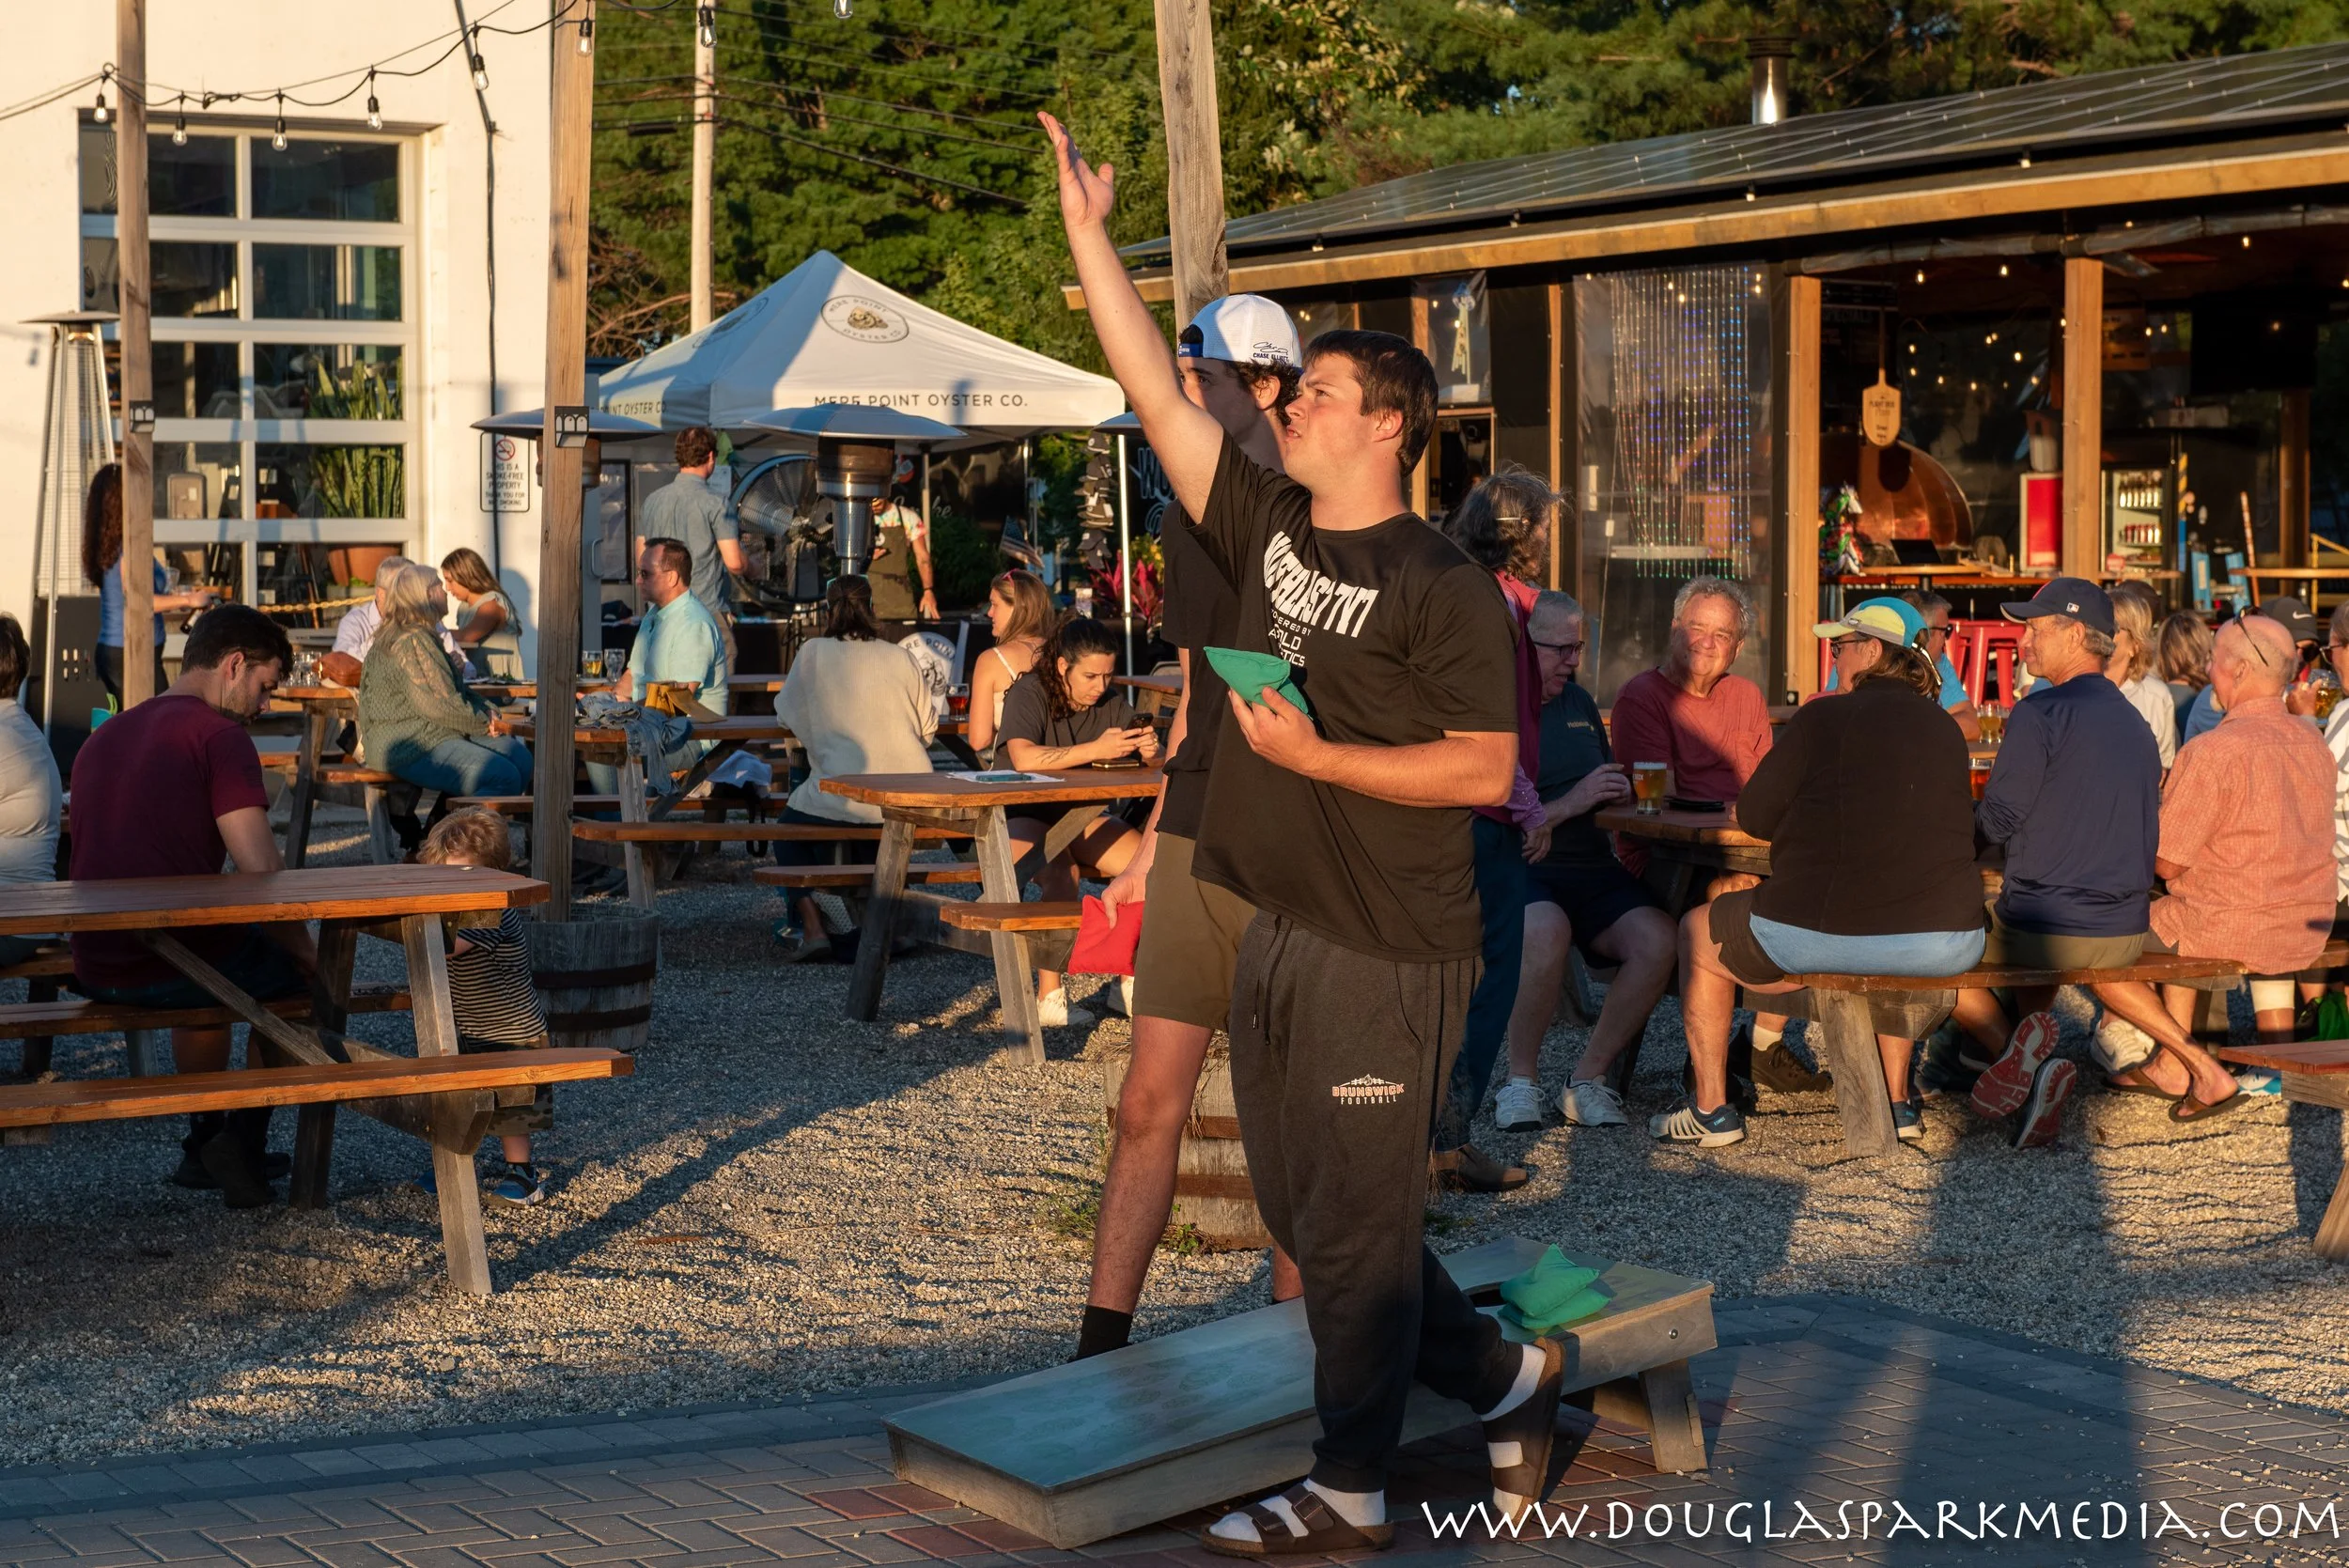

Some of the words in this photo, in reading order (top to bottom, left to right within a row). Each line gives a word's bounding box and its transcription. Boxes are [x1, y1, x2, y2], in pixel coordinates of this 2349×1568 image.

[868, 395, 921, 407] POINT
[927, 395, 993, 407] OYSTER
[1000, 395, 1029, 407] CO.
[624, 401, 654, 415] OYSTER
[1301, 627, 1312, 636] BY
[926, 638, 953, 656] POIN
[1331, 1083, 1405, 1097] BRUNSWICK
[1340, 1094, 1397, 1105] FOOTBALL
